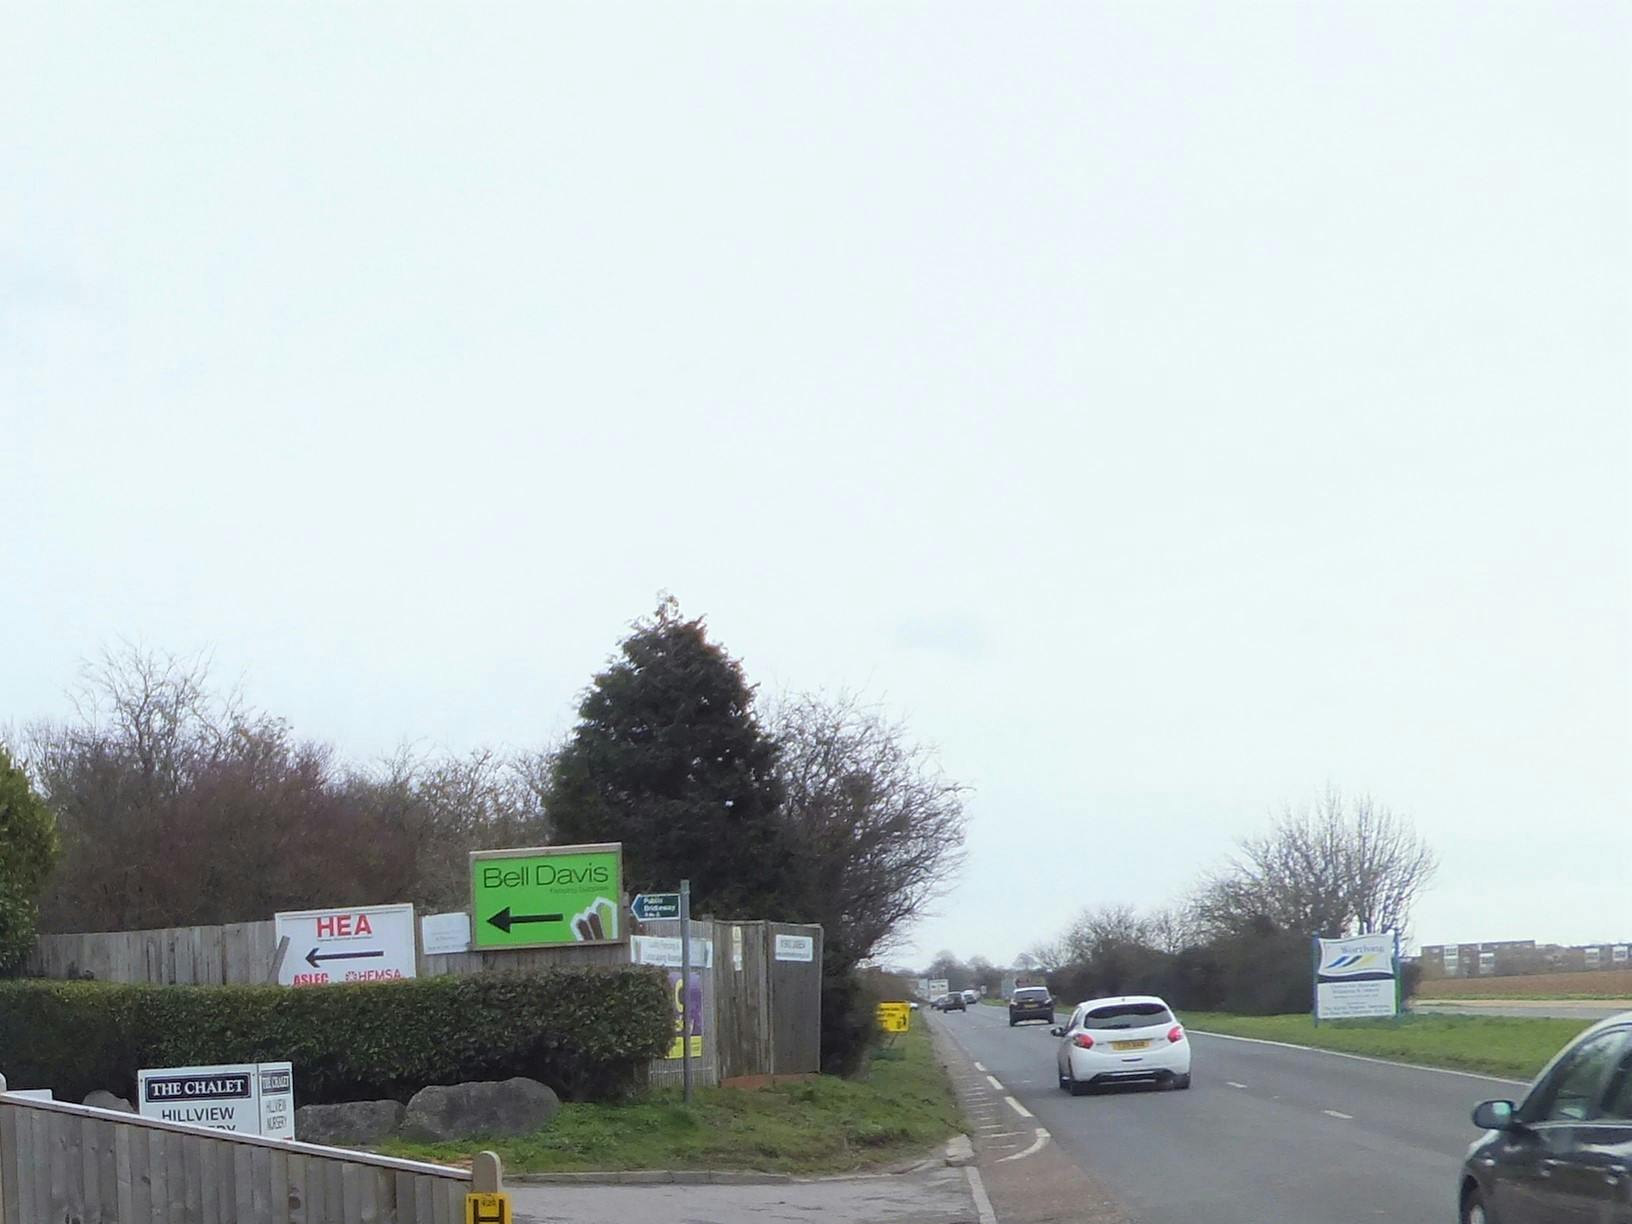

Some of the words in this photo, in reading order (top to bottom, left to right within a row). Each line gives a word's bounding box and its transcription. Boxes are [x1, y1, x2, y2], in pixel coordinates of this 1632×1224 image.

[483, 866, 529, 888] Bell
[536, 863, 609, 886] Davis
[316, 913, 373, 937] HEA
[151, 1082, 182, 1097] THE
[184, 1079, 245, 1095] CHALET
[162, 1107, 235, 1122] HILLVIEW
